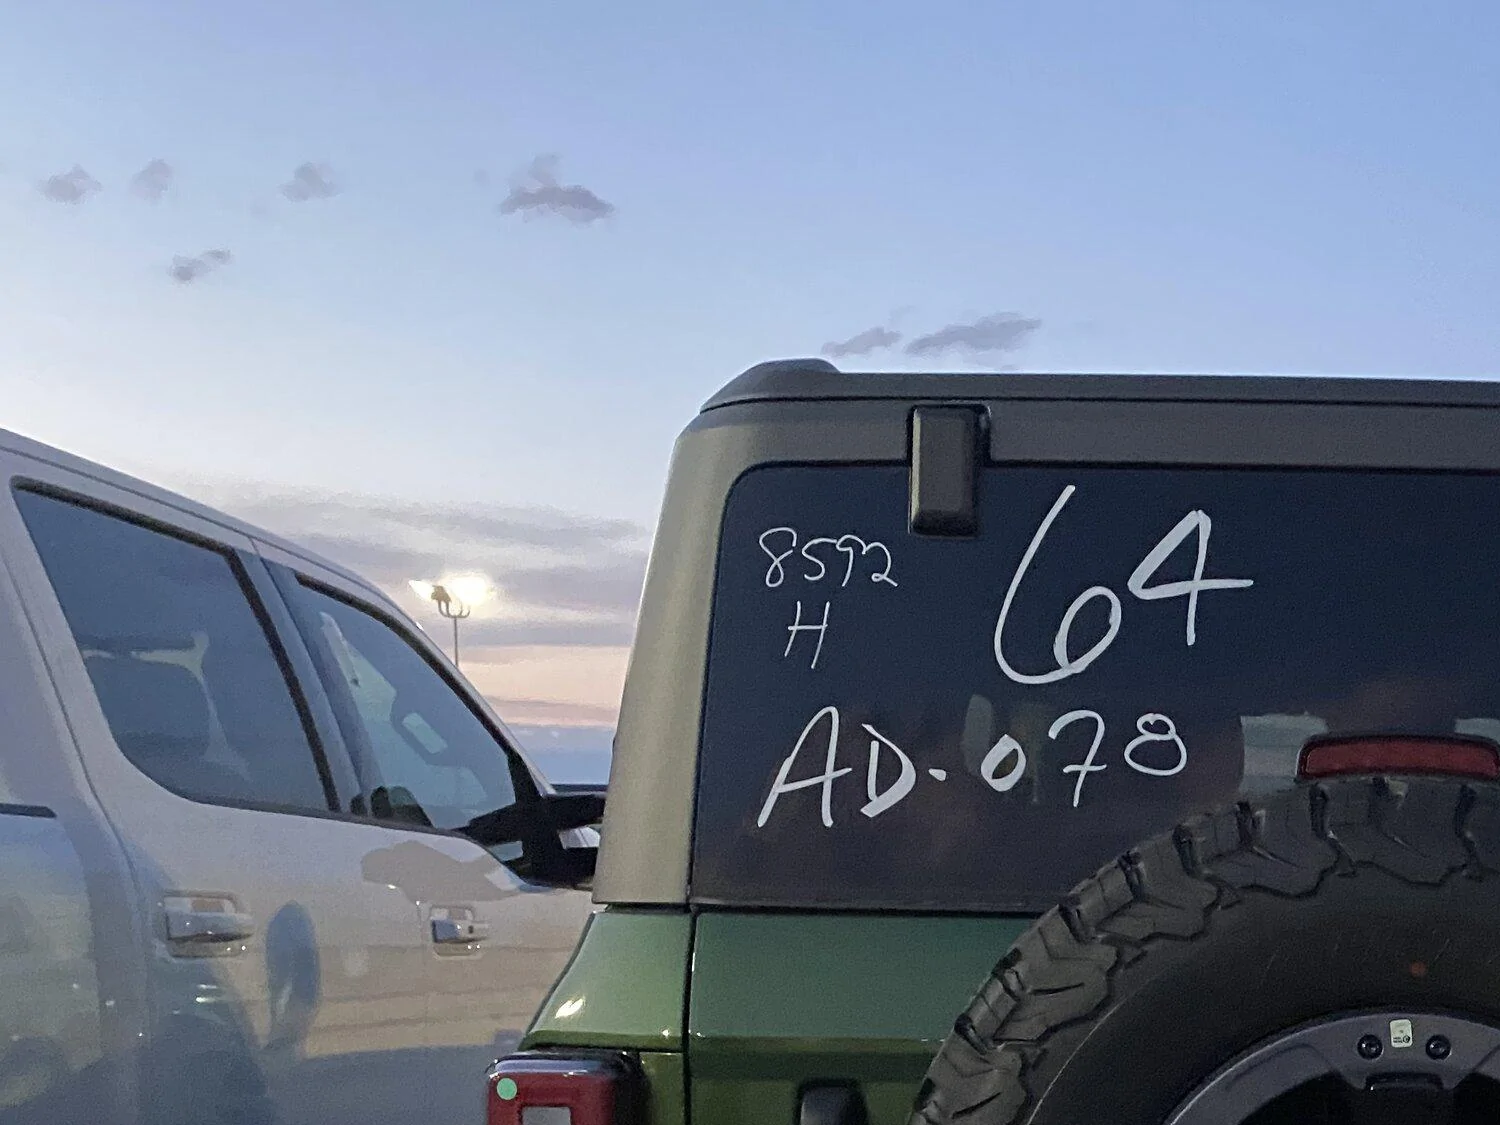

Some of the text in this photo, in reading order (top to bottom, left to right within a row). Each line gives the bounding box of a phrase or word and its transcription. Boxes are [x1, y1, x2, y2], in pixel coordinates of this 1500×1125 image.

[757, 526, 900, 589] 8592
[993, 484, 1255, 685] 64
[783, 600, 830, 670] H
